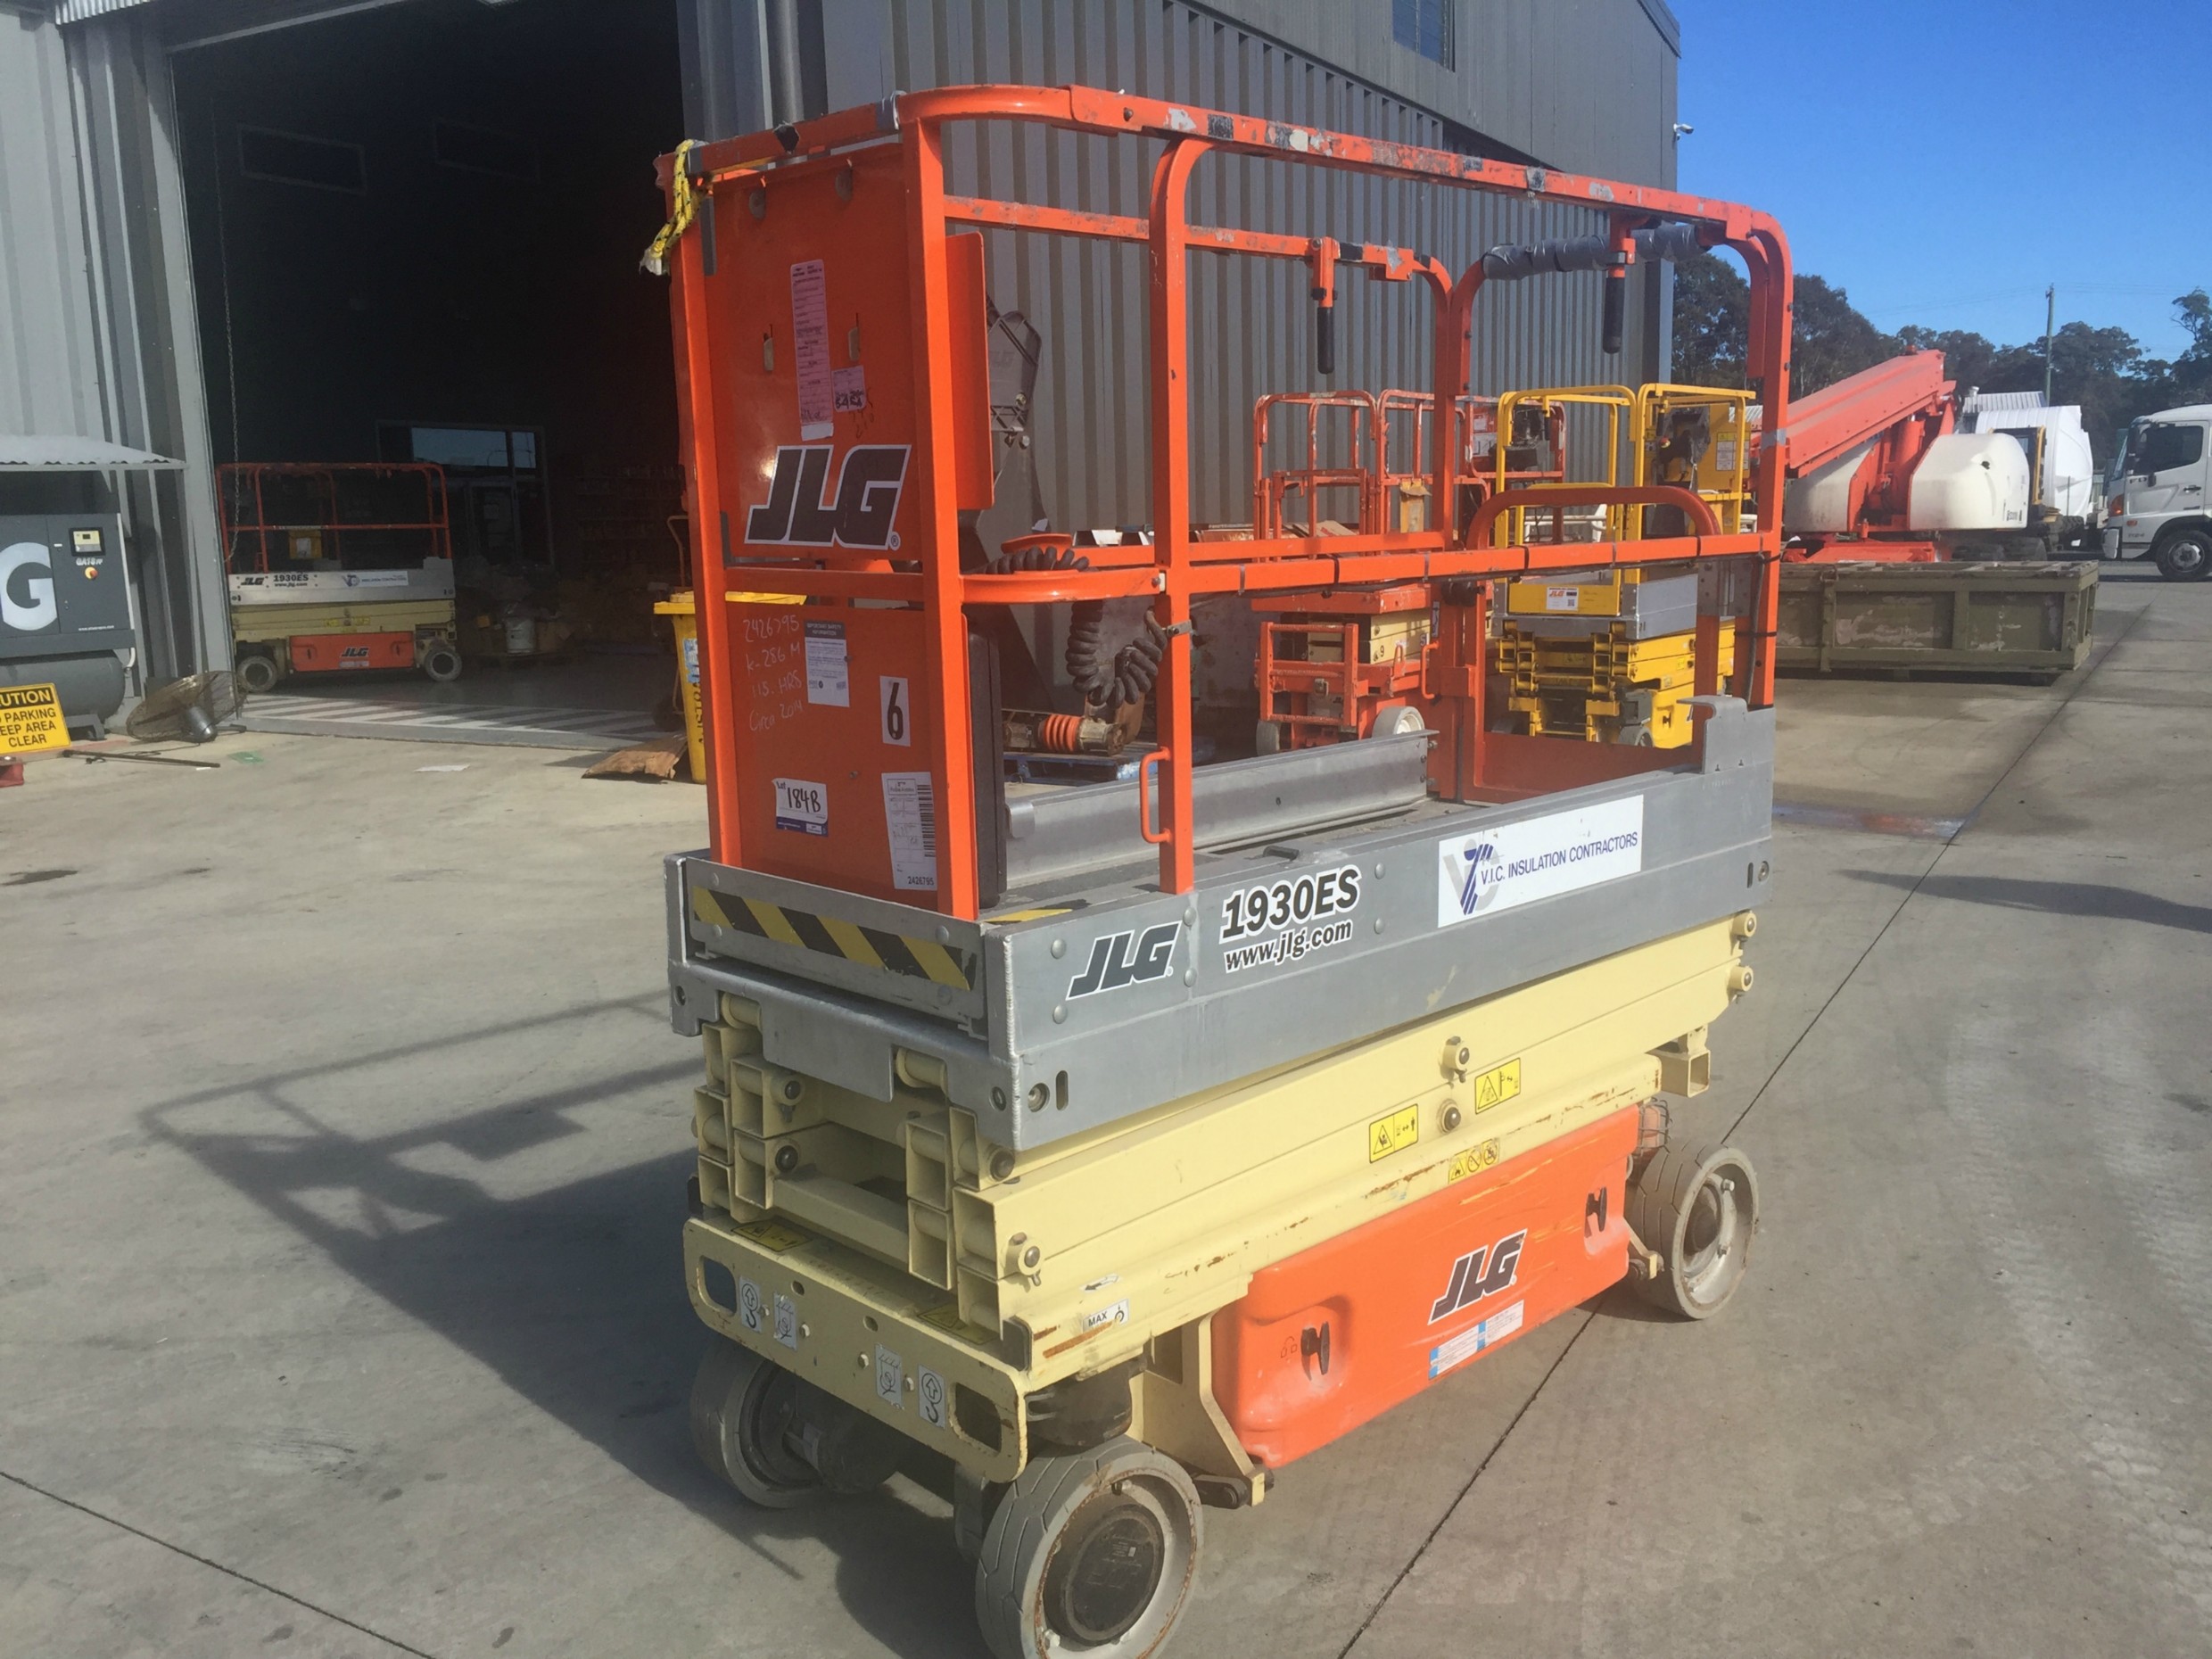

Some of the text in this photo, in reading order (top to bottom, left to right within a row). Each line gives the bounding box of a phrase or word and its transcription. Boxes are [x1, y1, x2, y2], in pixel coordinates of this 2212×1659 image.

[746, 445, 911, 549] JLG
[240, 577, 264, 585] JLG
[273, 574, 309, 582] 1930ES
[340, 647, 369, 657] JLG
[0, 689, 52, 706] UTION
[4, 707, 56, 722] PARKING
[887, 681, 904, 740] 6
[0, 721, 56, 736] EEP AREA
[8, 734, 46, 747] CLEAR
[1481, 831, 1638, 885] V.I.C. INSULATION CONTRACTORS
[907, 876, 935, 886] 2426795
[1221, 865, 1361, 942] 1930ES
[1226, 920, 1352, 972] www.jlg.com
[1066, 920, 1183, 1000] JLG
[1427, 1228, 1528, 1325] JLG
[1088, 1311, 1107, 1327] MAX
